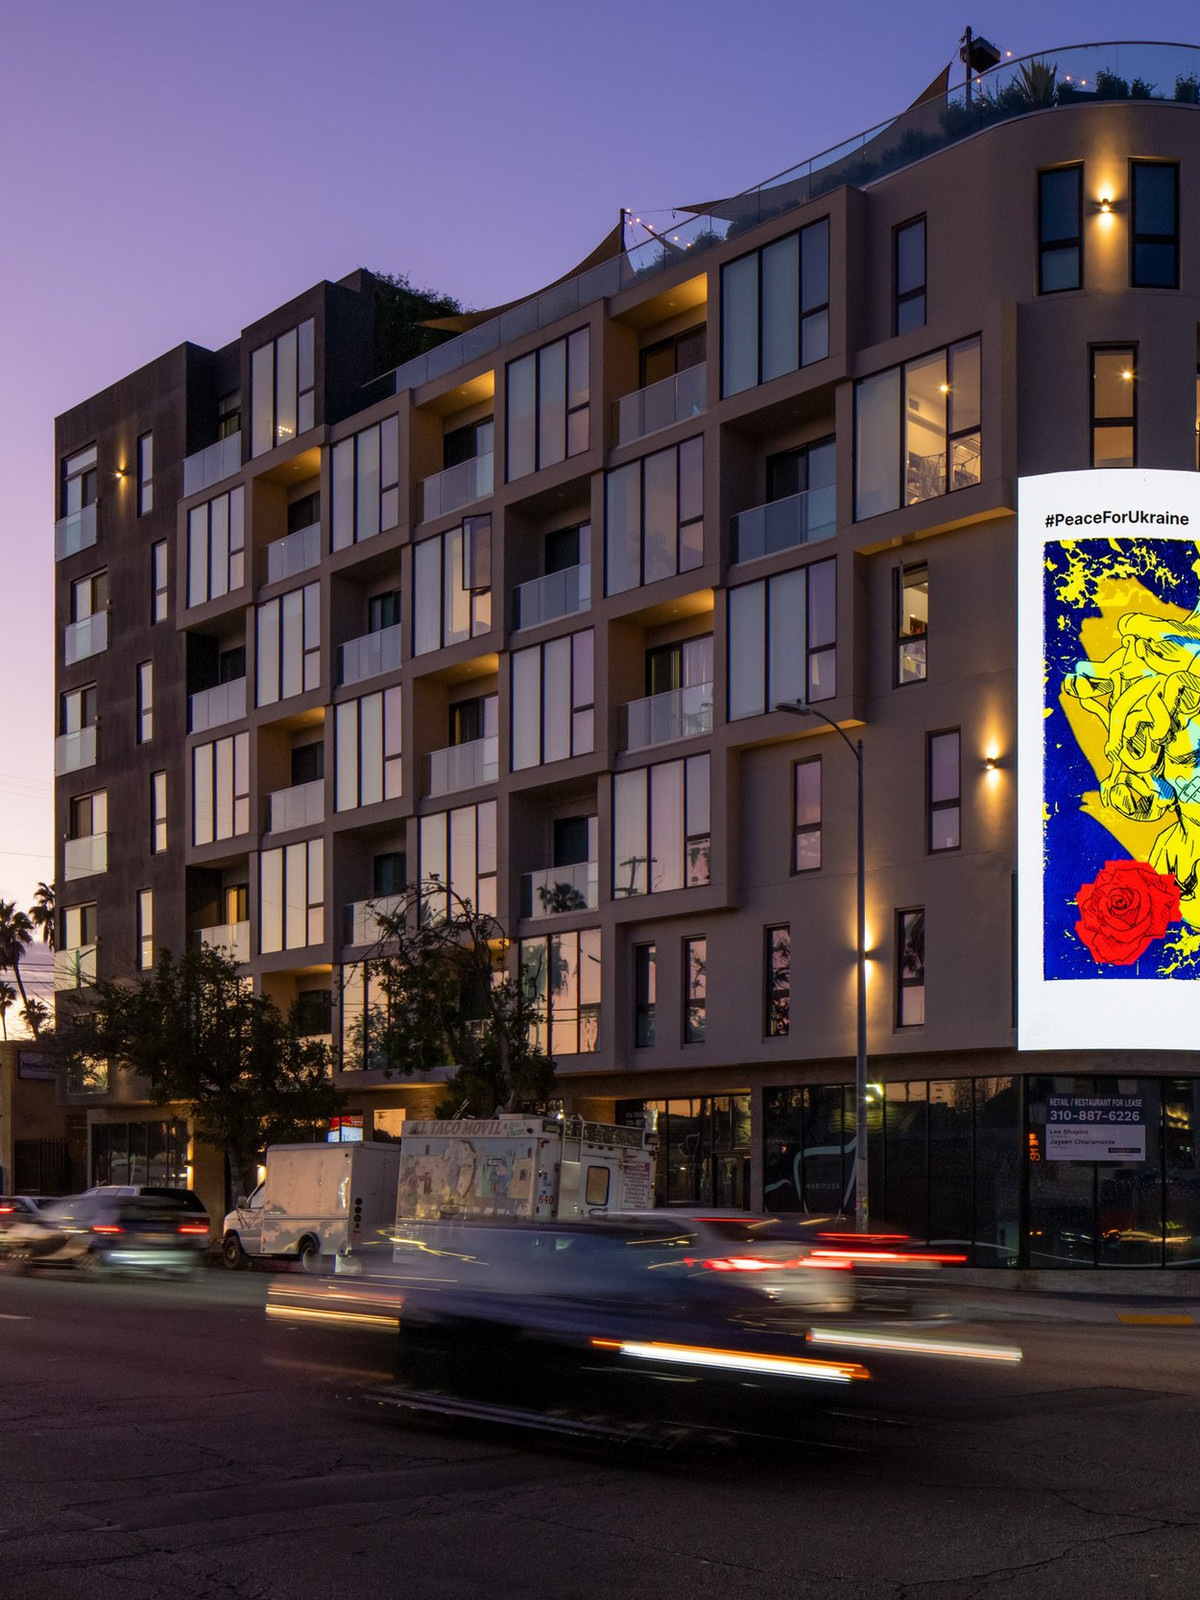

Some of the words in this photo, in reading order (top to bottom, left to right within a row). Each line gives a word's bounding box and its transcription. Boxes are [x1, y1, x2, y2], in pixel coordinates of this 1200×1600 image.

[1045, 511, 1190, 528] #PeaceForUkraine
[1049, 1098, 1070, 1107] RETAIL
[1074, 1098, 1112, 1107] RESTAURANT
[1112, 1099, 1124, 1107] FOR
[1124, 1098, 1143, 1108] LEASE
[1050, 1110, 1140, 1121] 310-887-6226
[430, 1121, 461, 1135] TACO
[461, 1121, 503, 1135] MOVIL
[538, 1194, 553, 1204] 640
